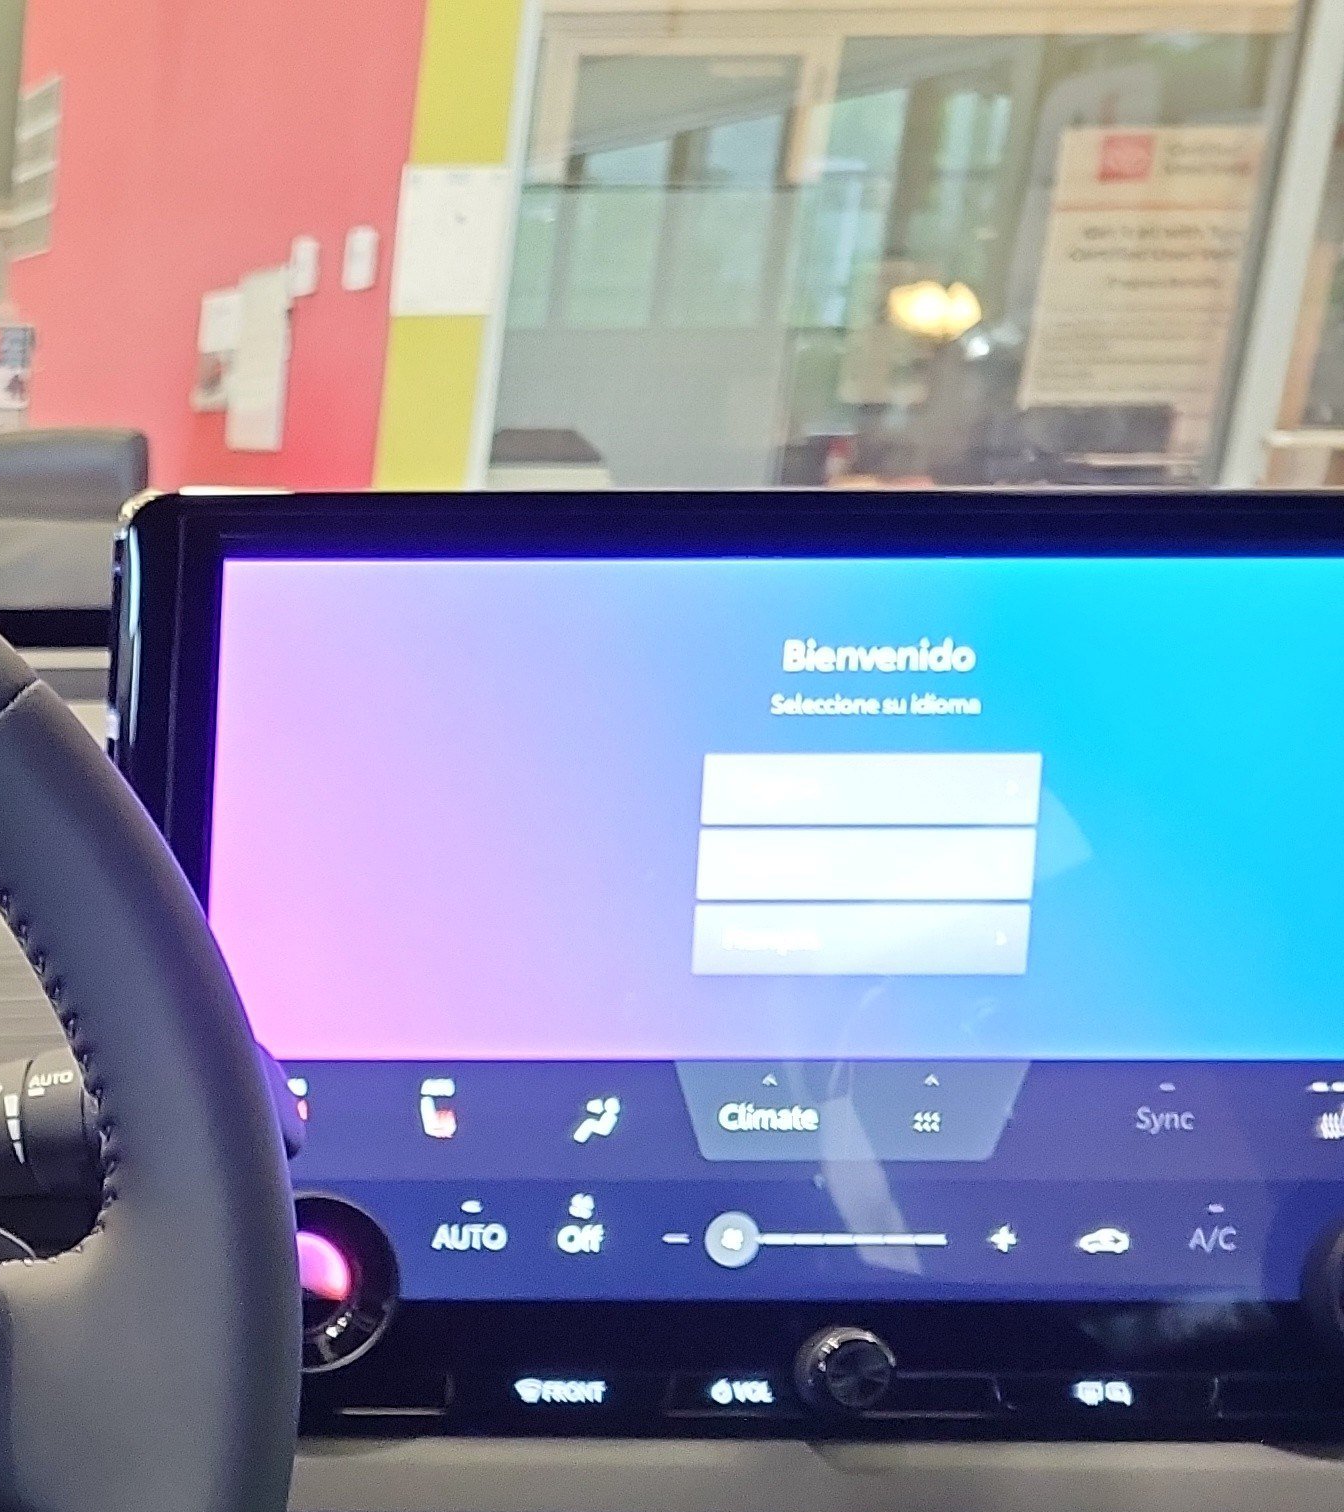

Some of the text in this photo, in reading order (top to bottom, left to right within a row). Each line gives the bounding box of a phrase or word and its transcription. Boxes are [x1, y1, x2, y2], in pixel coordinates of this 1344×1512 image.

[782, 637, 977, 673] Bienvenido
[770, 692, 880, 716] Seleccione
[882, 697, 907, 715] su
[29, 1071, 74, 1088] AUTO
[717, 1101, 820, 1132] Climate
[1135, 1106, 1195, 1135] Sync
[431, 1222, 508, 1252] AUTO
[556, 1223, 605, 1255] Off
[1188, 1226, 1238, 1254] A/C
[542, 1379, 608, 1404] FRONT
[733, 1379, 774, 1404] VOL
